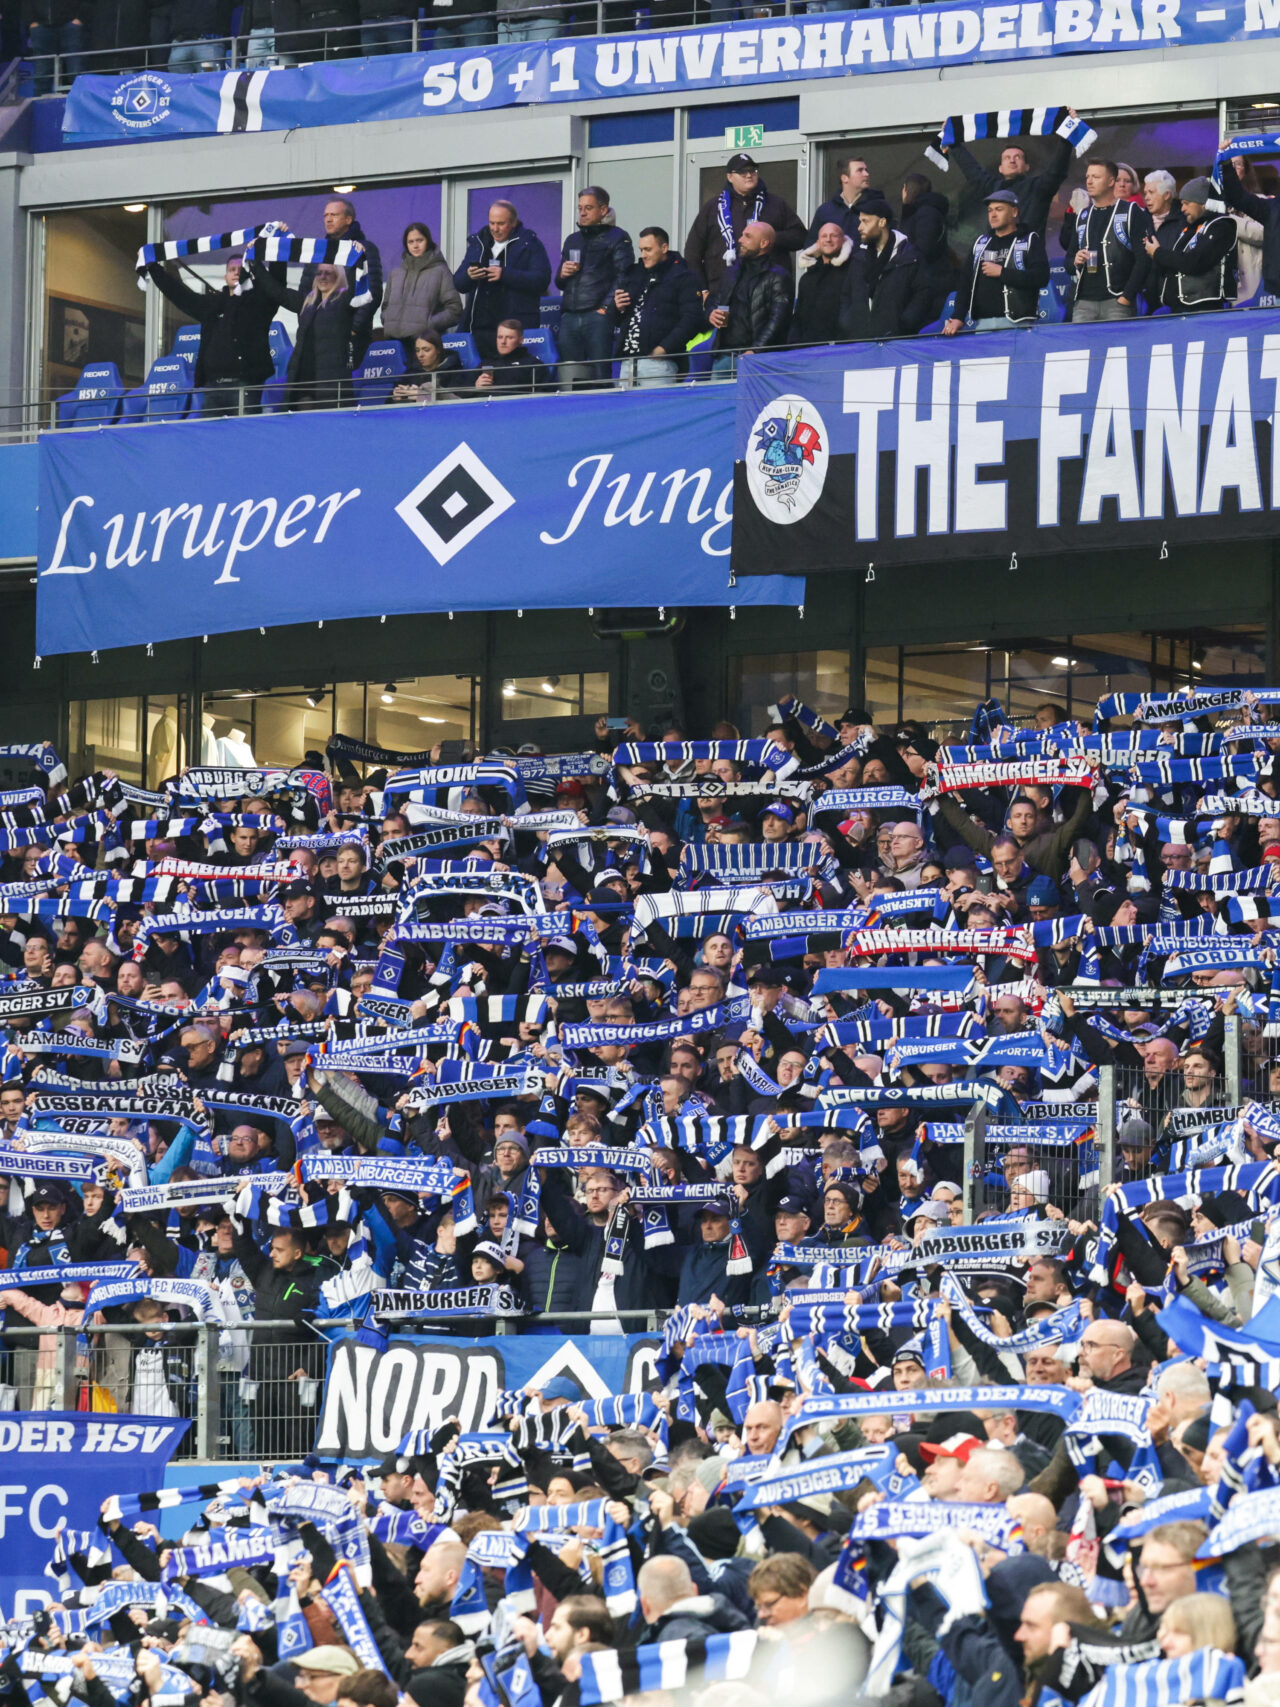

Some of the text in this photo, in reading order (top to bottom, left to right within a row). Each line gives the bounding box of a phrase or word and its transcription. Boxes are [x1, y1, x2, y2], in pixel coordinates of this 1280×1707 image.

[423, 57, 494, 107] 50
[508, 61, 534, 93] +
[549, 47, 580, 93] 1
[595, 0, 1182, 87] UNVERHANDELBAR
[111, 96, 123, 106] 18
[160, 96, 170, 106] 87
[112, 109, 170, 128] SUPPORTERS CLUB
[363, 367, 383, 379] HSV
[78, 389, 98, 400] HSV
[148, 382, 170, 394] HSV
[842, 356, 1010, 542] THE
[40, 488, 361, 584] Luruper
[419, 765, 478, 785] MOIN
[942, 761, 1061, 788] HAMBURGER
[336, 906, 393, 917] STADION
[543, 915, 568, 929] S.V.
[841, 913, 862, 928] S.V.
[858, 928, 997, 950] HAMBURGER
[45, 993, 68, 1007] SV
[566, 1010, 717, 1044] HAMBURGER SV
[19, 1033, 115, 1050] HAMBURGER
[316, 1054, 391, 1070] HAMBURGER
[820, 1083, 1004, 1108] NORD TRIBUNE
[1046, 1125, 1077, 1140] S.V.
[537, 1150, 568, 1164] HSV
[572, 1150, 598, 1163] IST
[70, 1160, 91, 1173] SV
[628, 1186, 672, 1198] VEREIN
[125, 1195, 165, 1209] HEIMAT
[1037, 1230, 1065, 1248] SV
[317, 1344, 499, 1450] NORD
[925, 1389, 971, 1403] NUR
[978, 1387, 1020, 1401] DER
[0, 1421, 175, 1454] DER HSV
[755, 1470, 844, 1504] AUFSTEIGER
[0, 1484, 69, 1539] FC
